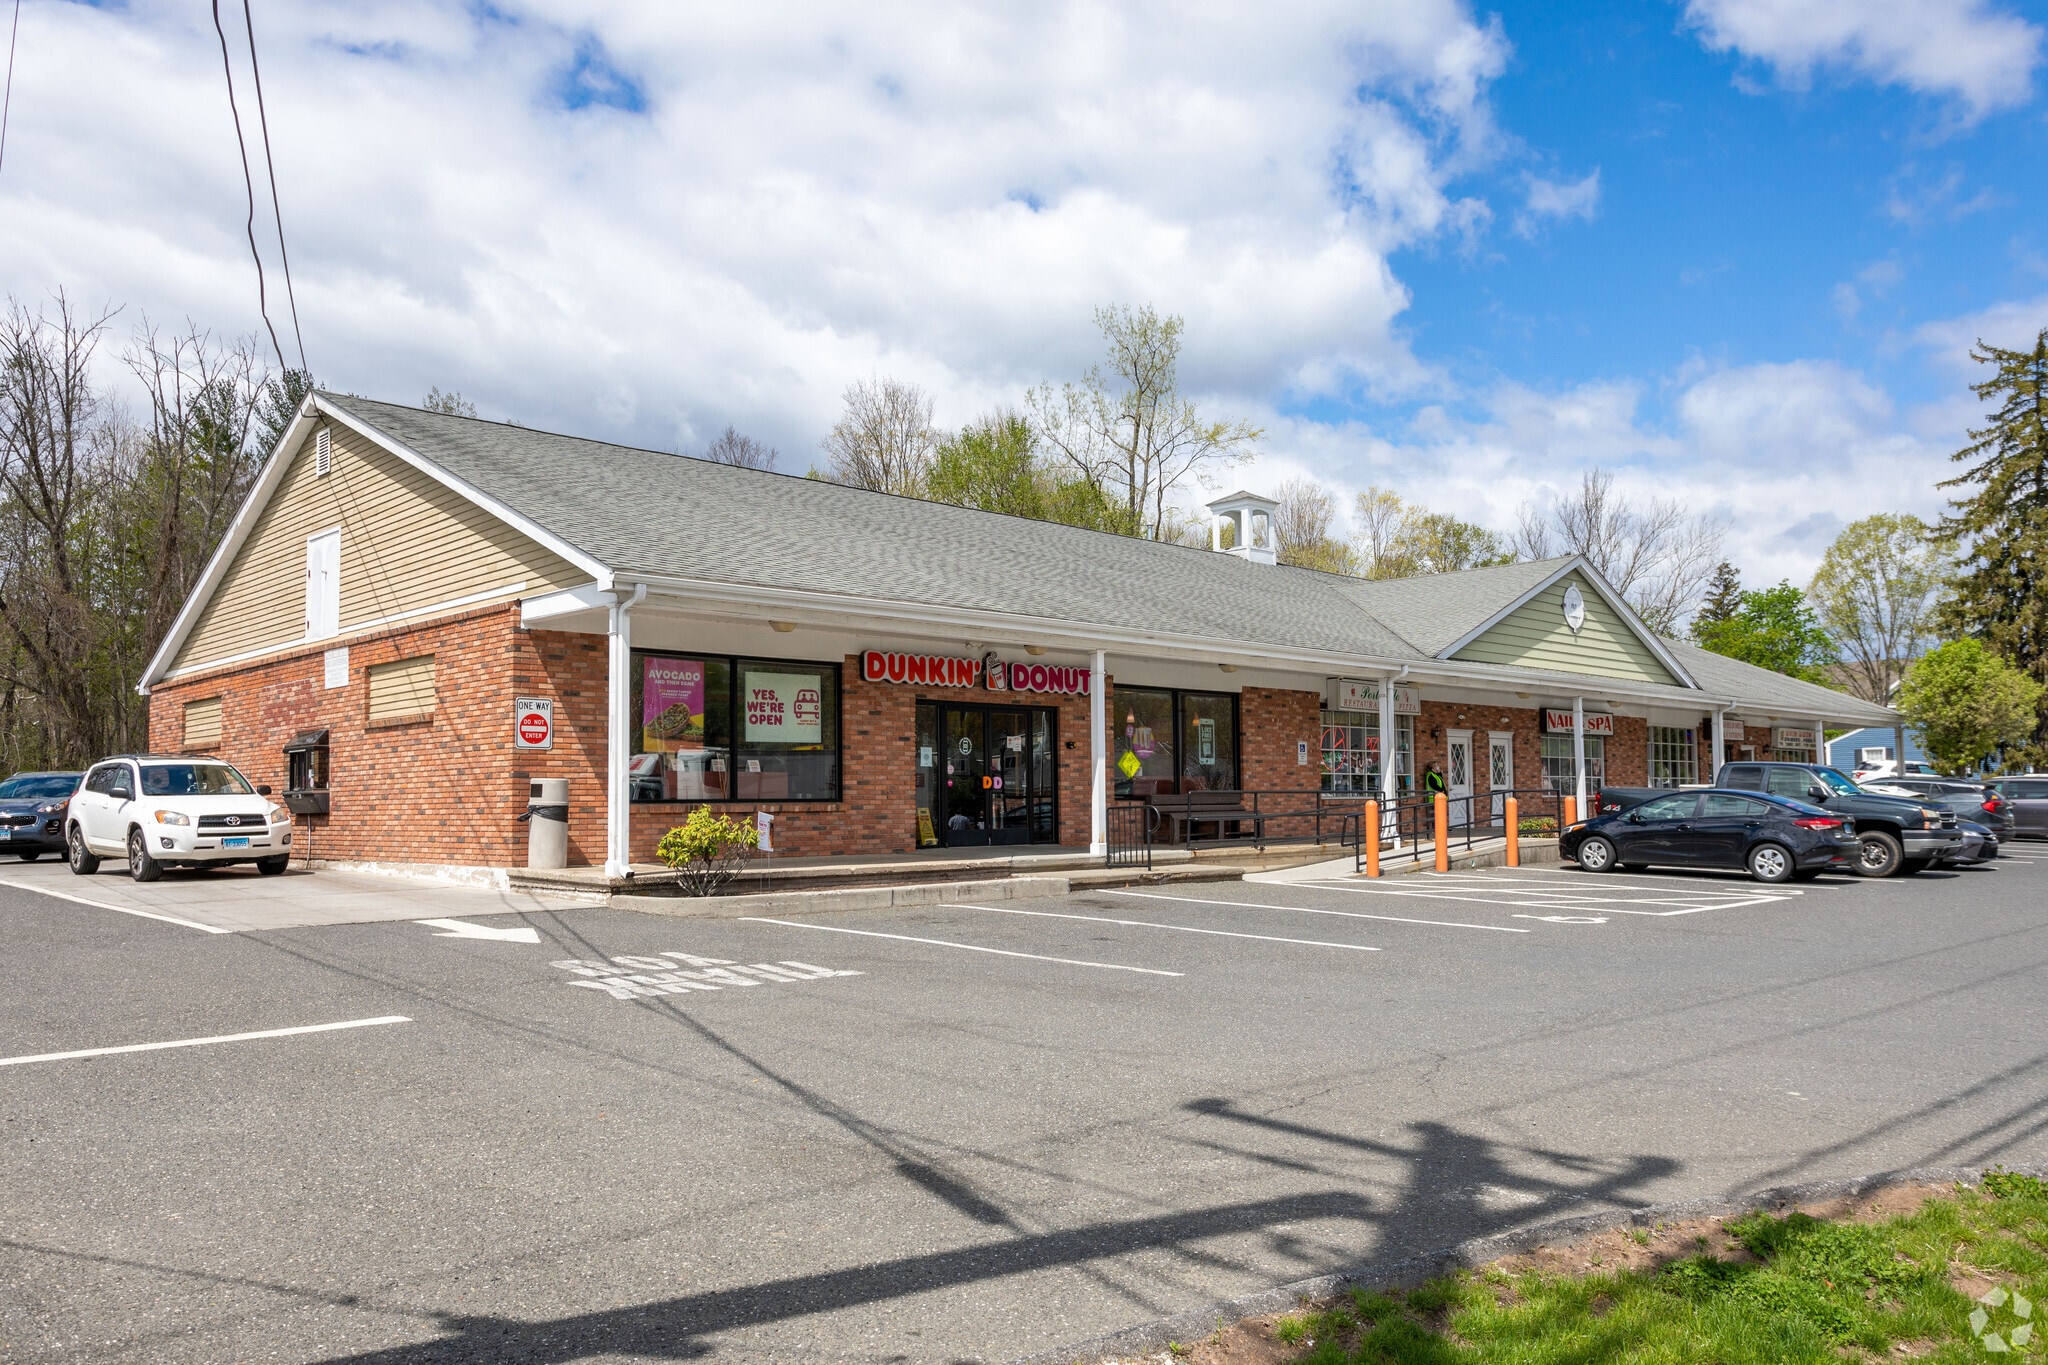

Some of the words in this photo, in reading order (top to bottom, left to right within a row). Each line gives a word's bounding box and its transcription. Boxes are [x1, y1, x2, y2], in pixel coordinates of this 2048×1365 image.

[648, 670, 700, 681] AVOCADO
[866, 651, 980, 687] DUNKIN'
[1013, 663, 1091, 693] DONUT
[752, 689, 778, 702] YES,
[519, 702, 533, 710] ONE
[536, 702, 550, 710] WAY
[747, 701, 784, 713] WE'RE
[1344, 699, 1378, 709] RESTAURA
[1399, 703, 1416, 711] PIZZA
[749, 714, 782, 725] OPEN
[1588, 716, 1612, 731] SPA
[550, 952, 737, 977] YOU
[566, 960, 865, 1000] THANK
